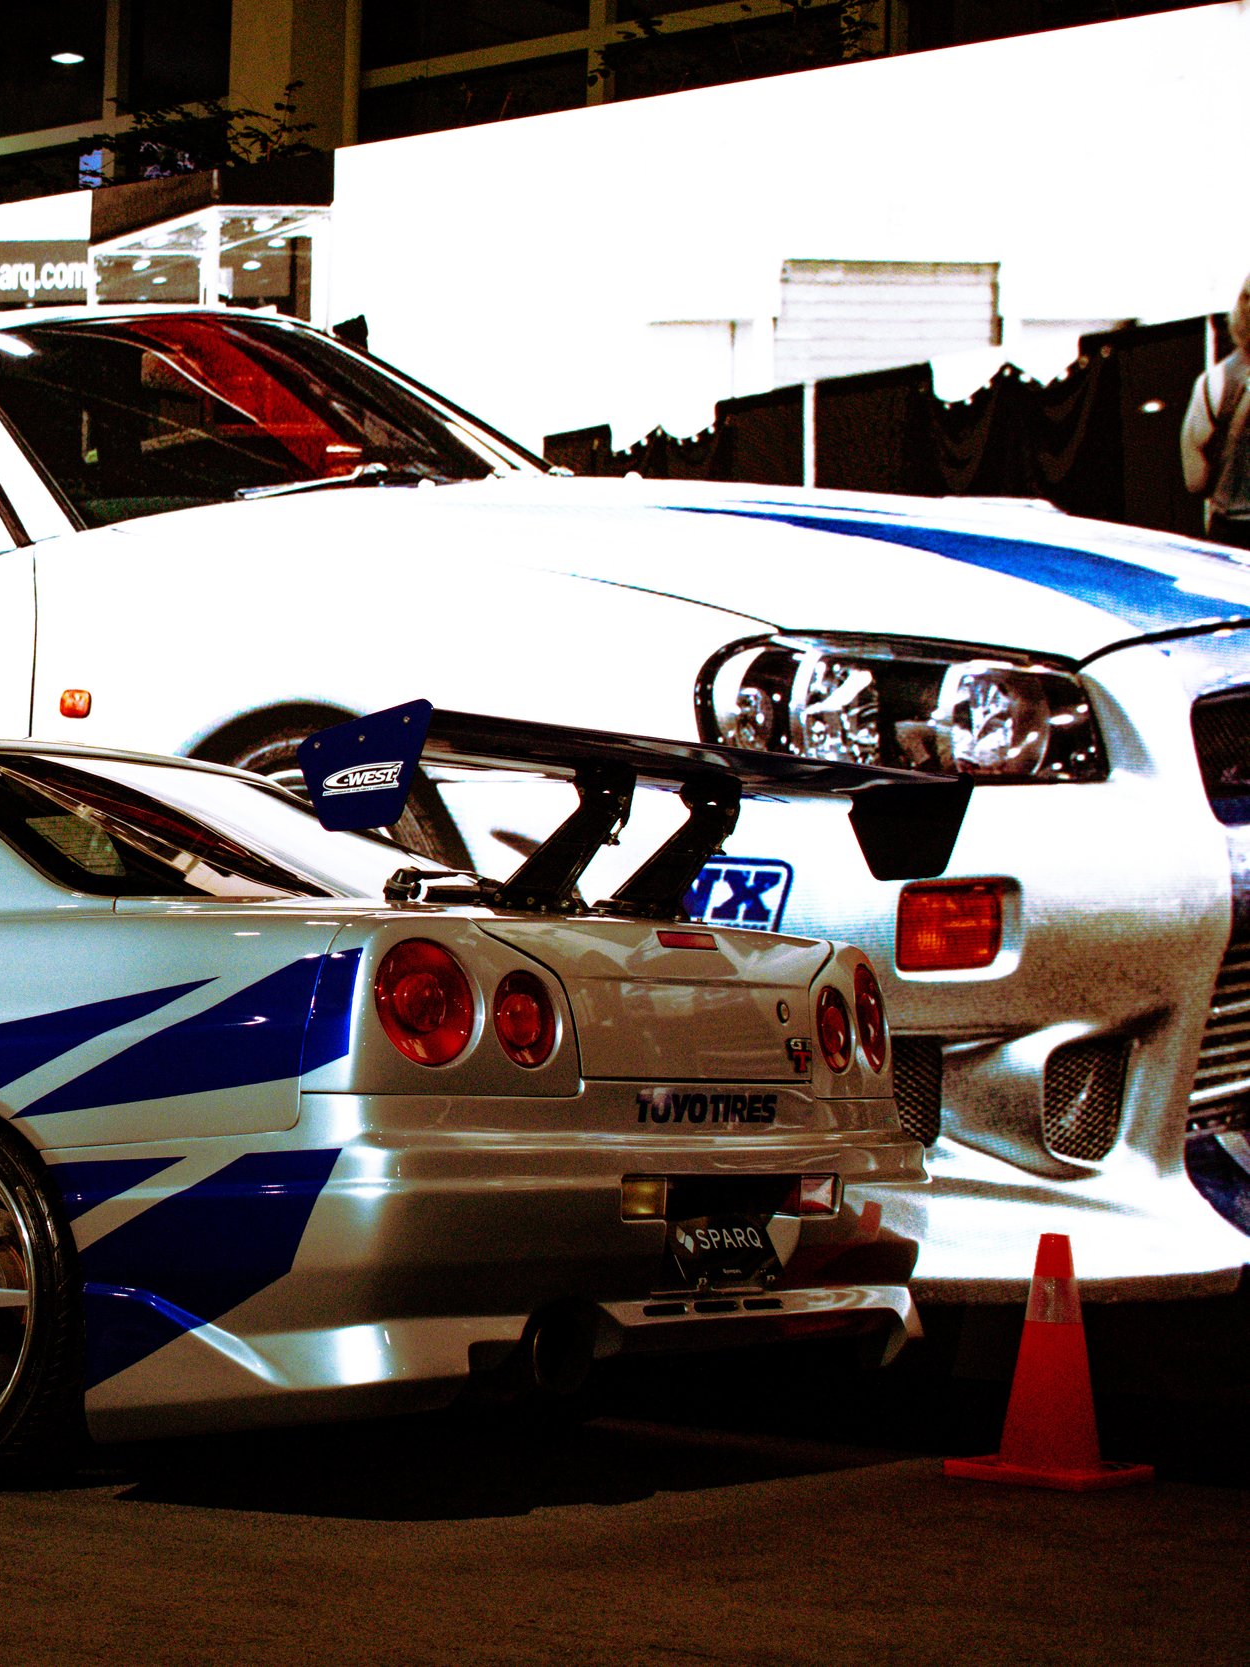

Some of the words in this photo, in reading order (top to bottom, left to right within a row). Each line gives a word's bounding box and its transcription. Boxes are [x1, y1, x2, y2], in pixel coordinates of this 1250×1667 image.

[636, 1092, 708, 1124] TOYO
[709, 1093, 778, 1124] TIRES
[695, 1226, 763, 1250] SPARQ
